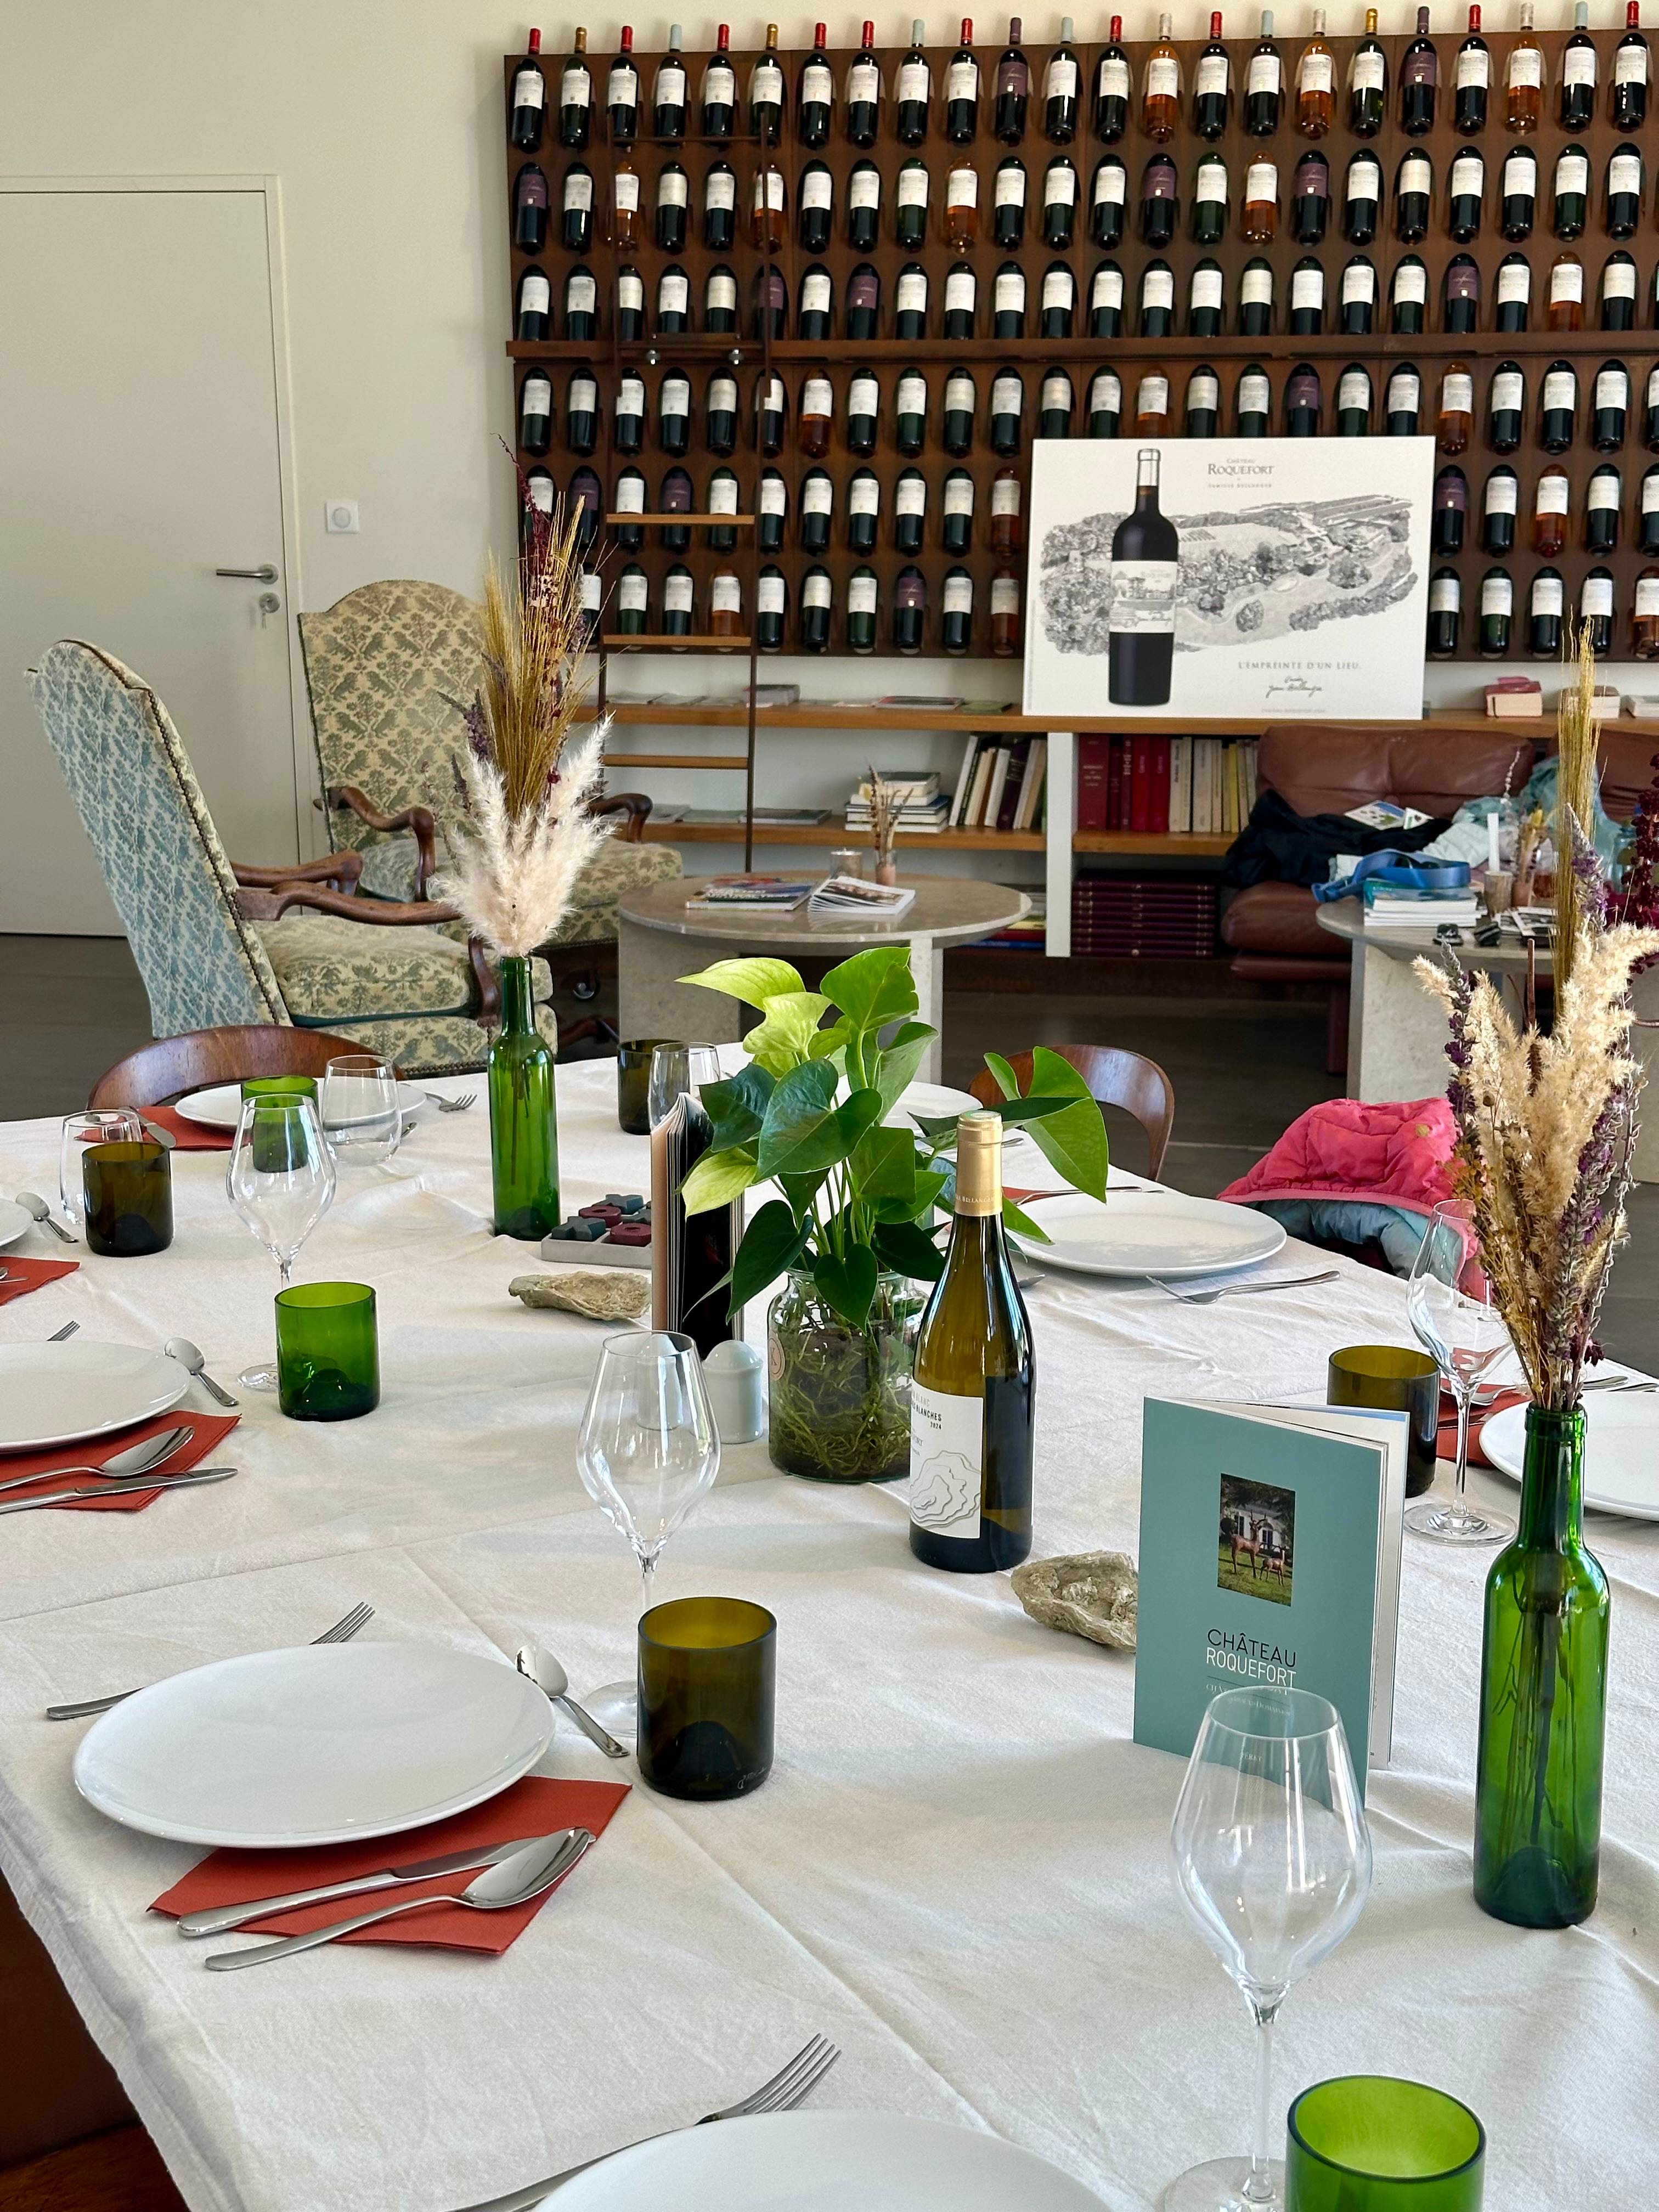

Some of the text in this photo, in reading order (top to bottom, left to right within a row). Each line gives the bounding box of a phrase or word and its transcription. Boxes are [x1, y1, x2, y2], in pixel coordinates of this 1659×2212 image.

[1207, 463, 1275, 476] ROQUEFORT
[1238, 661, 1301, 669] L'EMPREINTE
[1306, 661, 1332, 669] D'UN
[916, 1404, 943, 1422] BLANCHES
[1207, 1628, 1296, 1668] CHÂTEAU
[1206, 1646, 1297, 1689] ROQUEFORT
